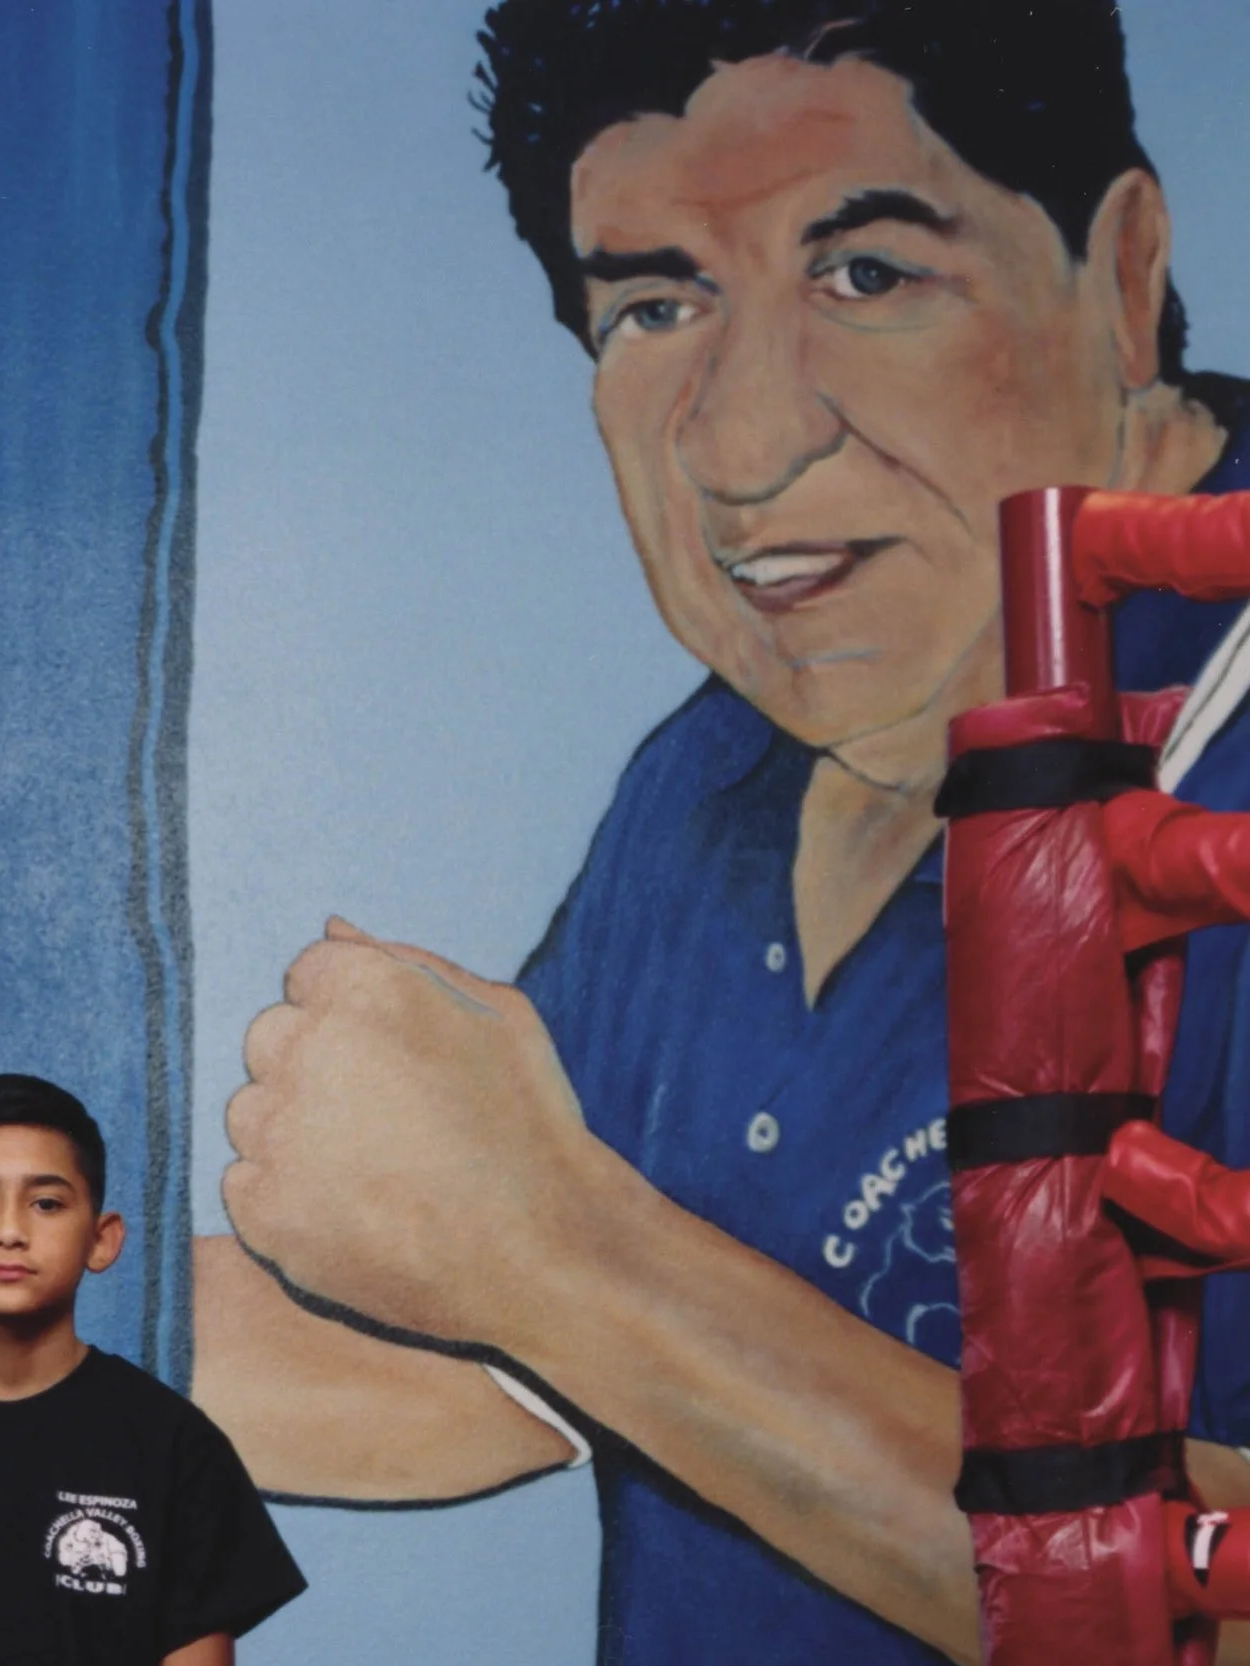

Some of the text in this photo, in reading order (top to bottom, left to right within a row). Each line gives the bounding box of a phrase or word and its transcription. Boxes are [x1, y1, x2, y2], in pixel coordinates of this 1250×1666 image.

[823, 1117, 948, 1268] COACHE
[57, 1490, 138, 1510] LEE ESPINOZA
[44, 1508, 147, 1568] COACHELLA VALLEY BOXING
[58, 1574, 124, 1595] CLUB
